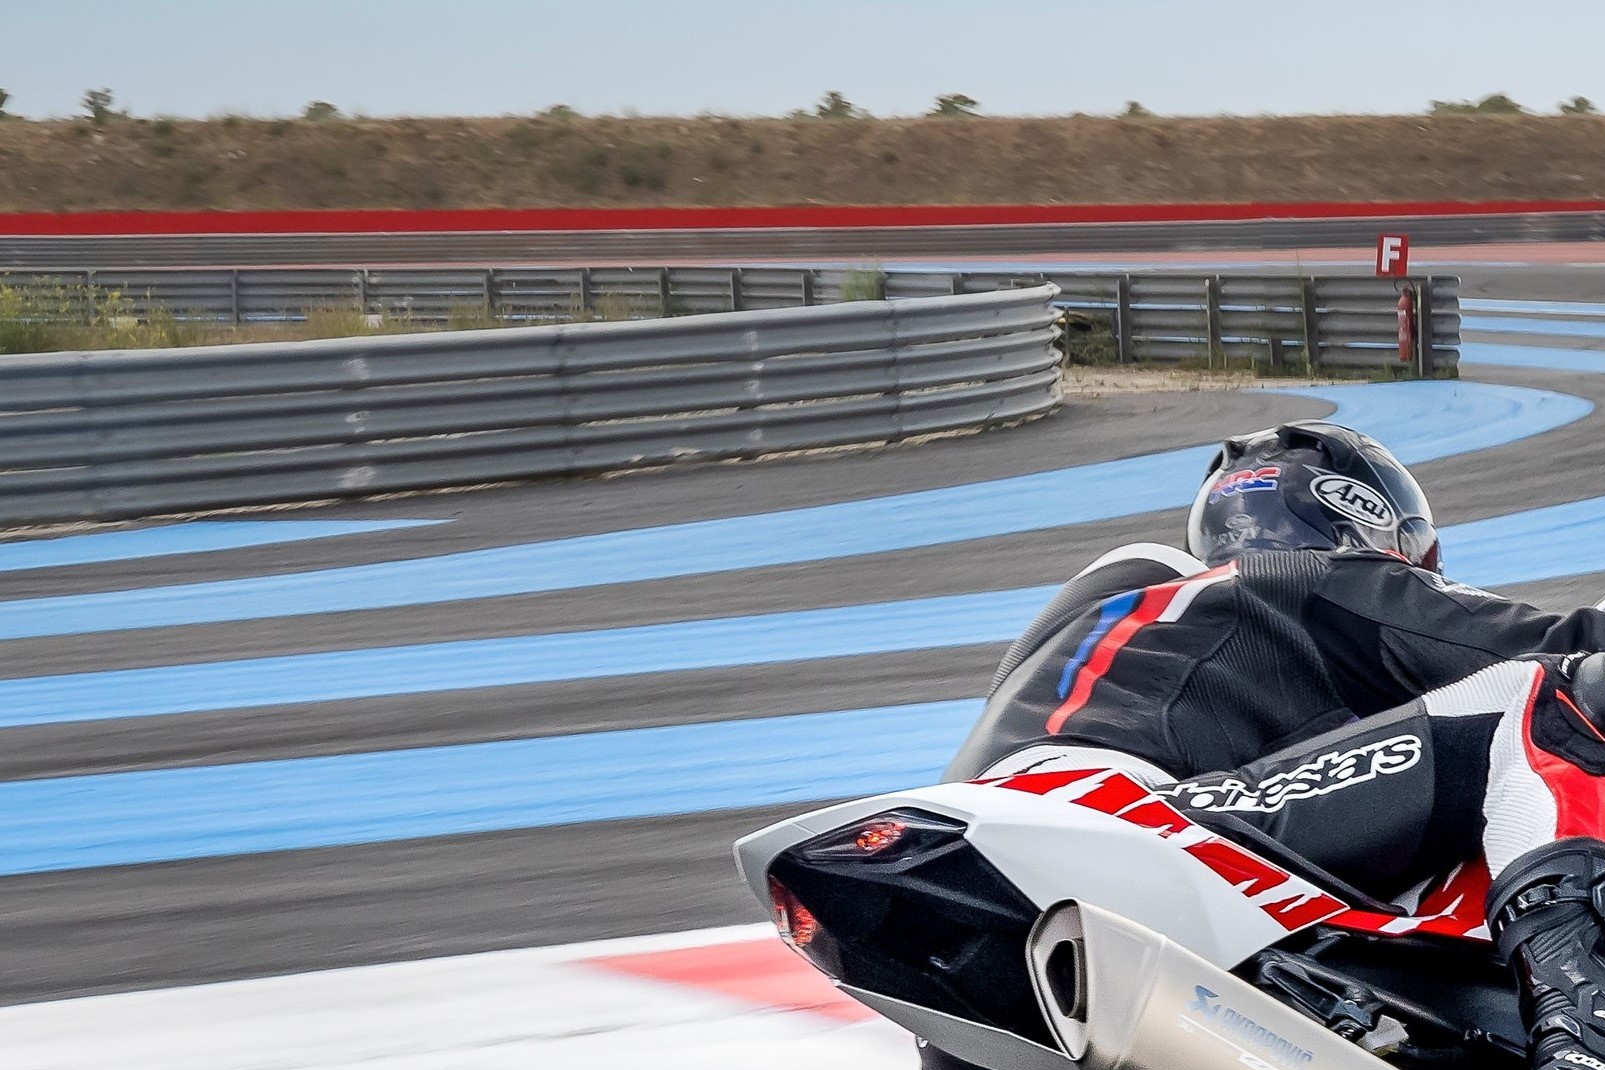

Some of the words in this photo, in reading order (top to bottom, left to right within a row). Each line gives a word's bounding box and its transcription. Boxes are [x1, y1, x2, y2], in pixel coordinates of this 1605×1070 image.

[1381, 236, 1401, 272] F
[1209, 467, 1281, 505] HRC
[1320, 484, 1386, 519] Arai
